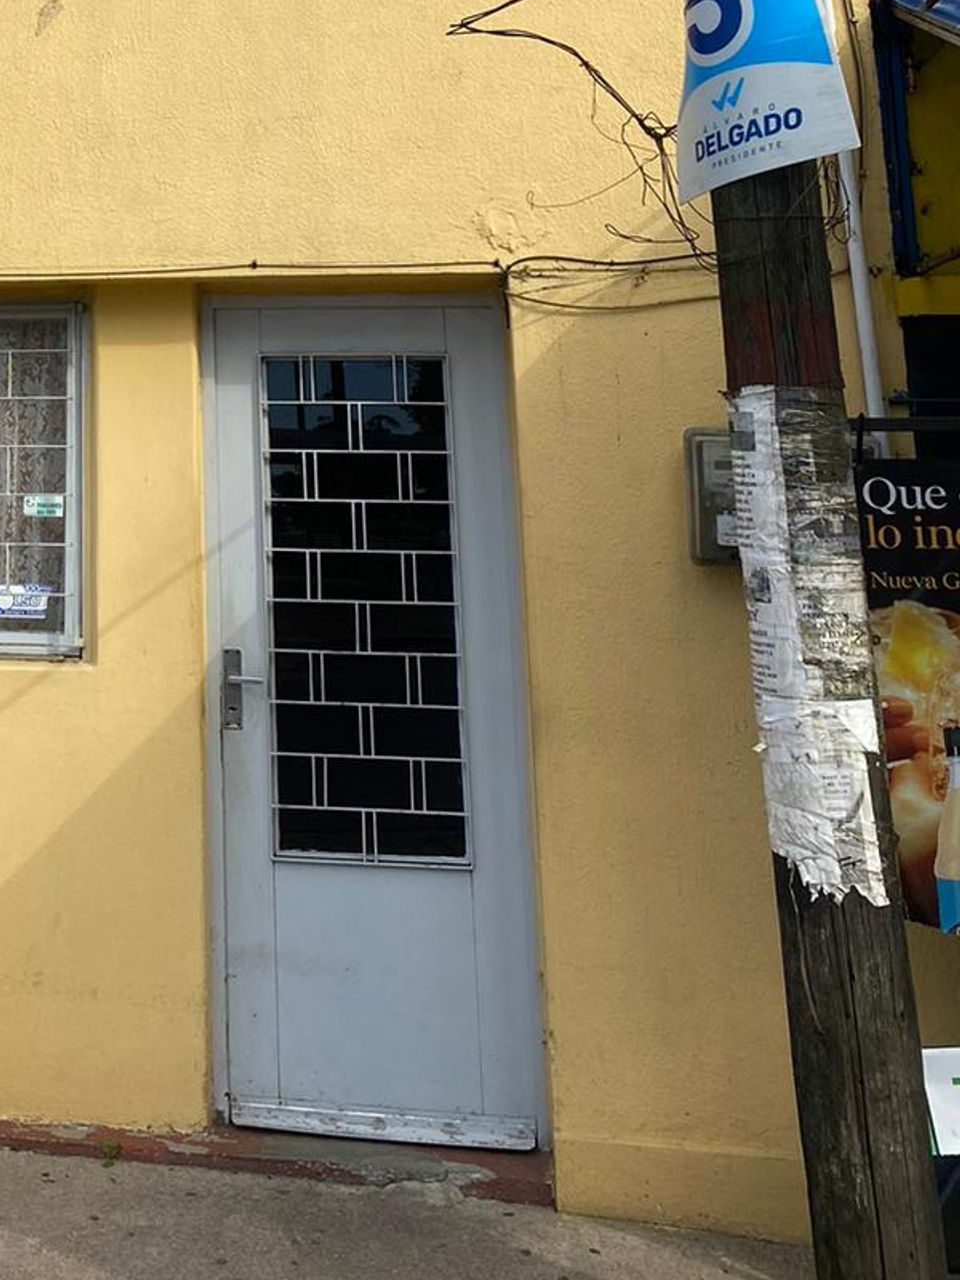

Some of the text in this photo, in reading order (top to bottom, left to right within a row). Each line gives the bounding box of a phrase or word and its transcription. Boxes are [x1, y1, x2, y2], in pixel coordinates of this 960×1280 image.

[694, 107, 803, 163] DELGADO
[711, 140, 782, 169] PRESIDENTE
[862, 476, 948, 515] Que
[865, 513, 960, 550] lo in
[870, 570, 938, 590] Nueva
